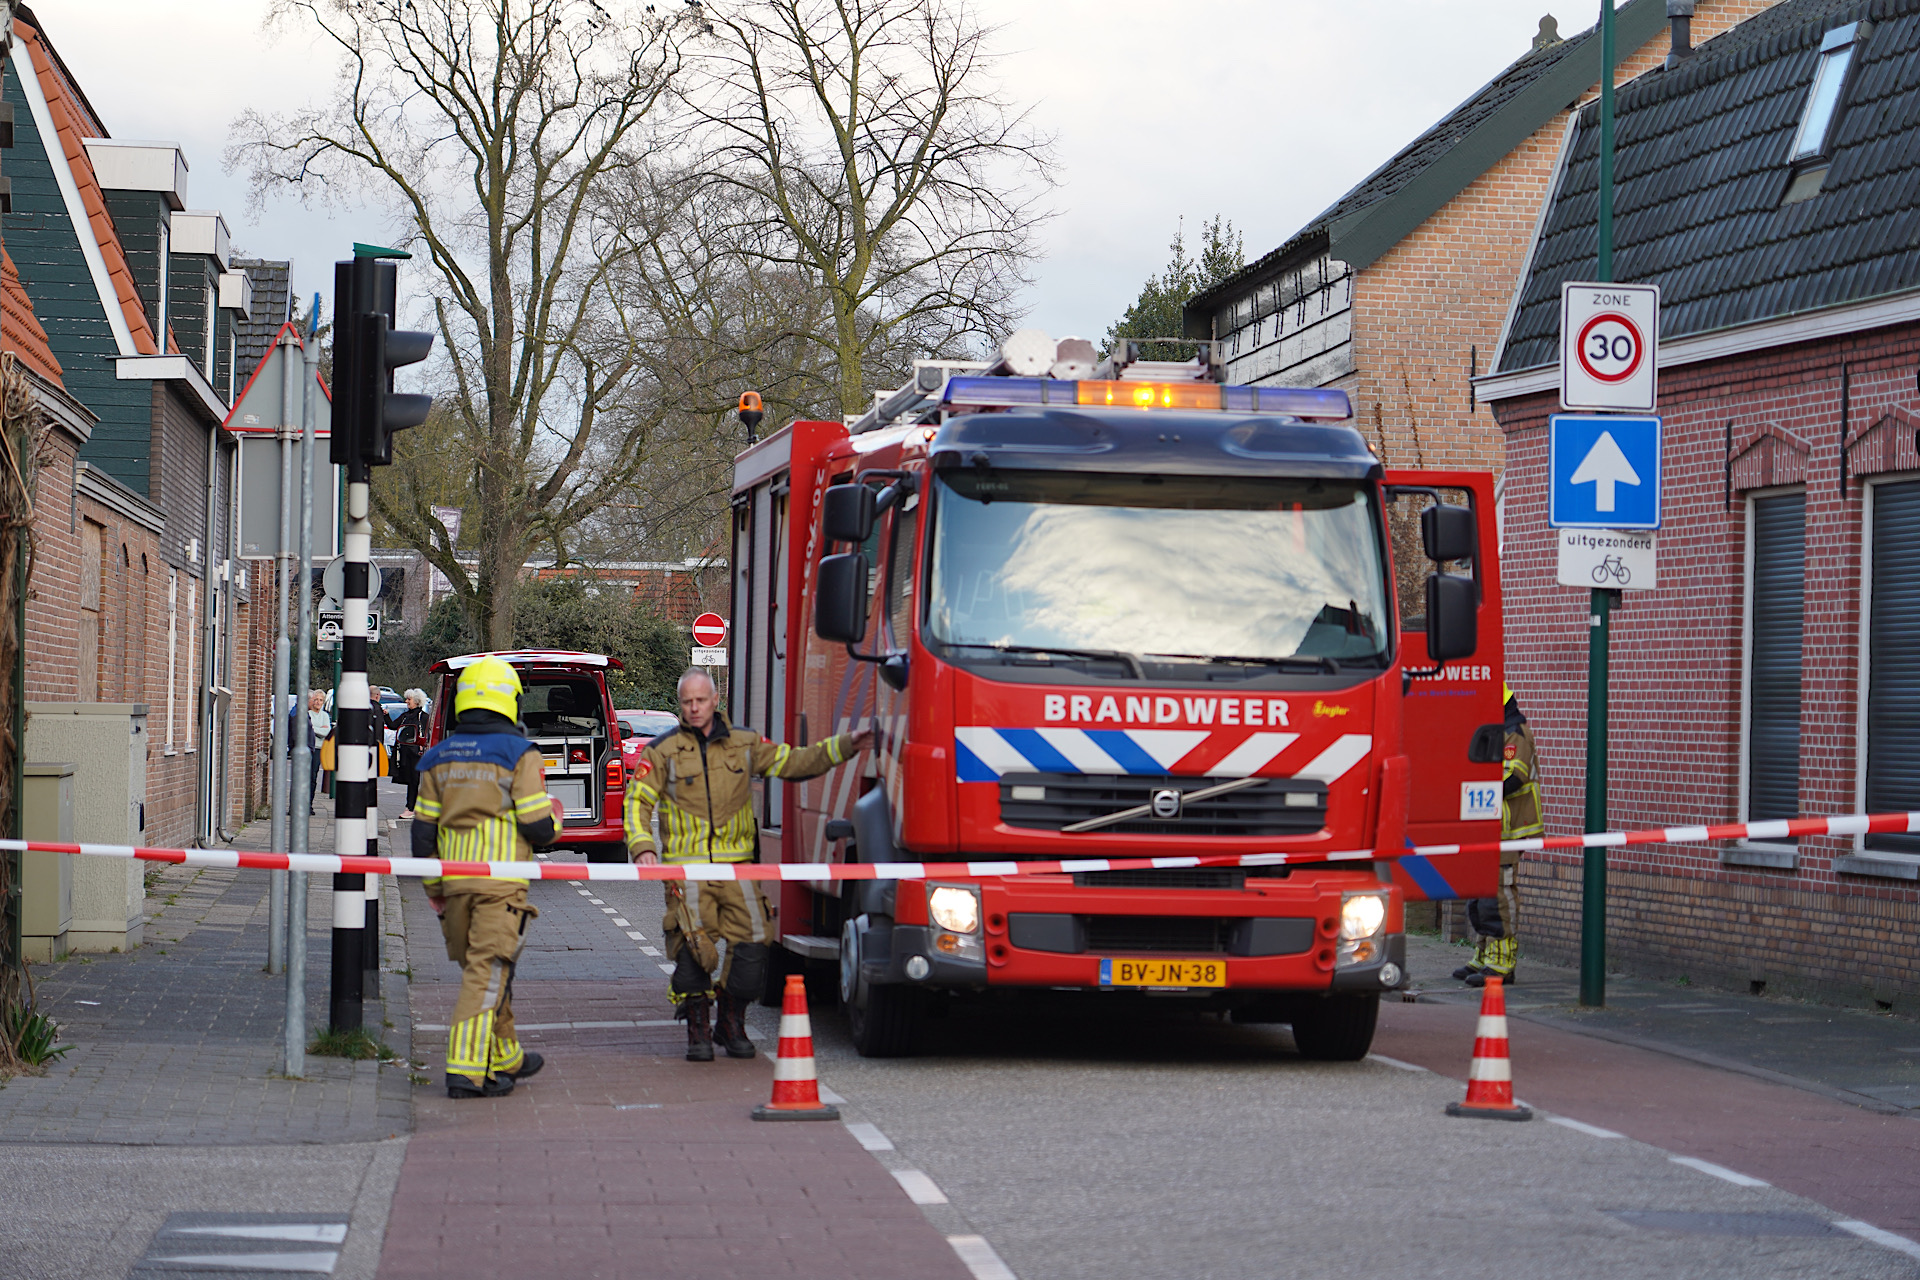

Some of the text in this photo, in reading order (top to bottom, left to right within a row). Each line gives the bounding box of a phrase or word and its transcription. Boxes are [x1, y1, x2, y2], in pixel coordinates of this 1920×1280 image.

[1592, 293, 1631, 306] ZONE
[1589, 334, 1632, 361] 30
[1567, 534, 1652, 550] uitgezonderd
[1401, 665, 1492, 681] ANDWEER
[1044, 694, 1290, 727] BRANDWEER
[1121, 963, 1217, 983] BV-JN-38
